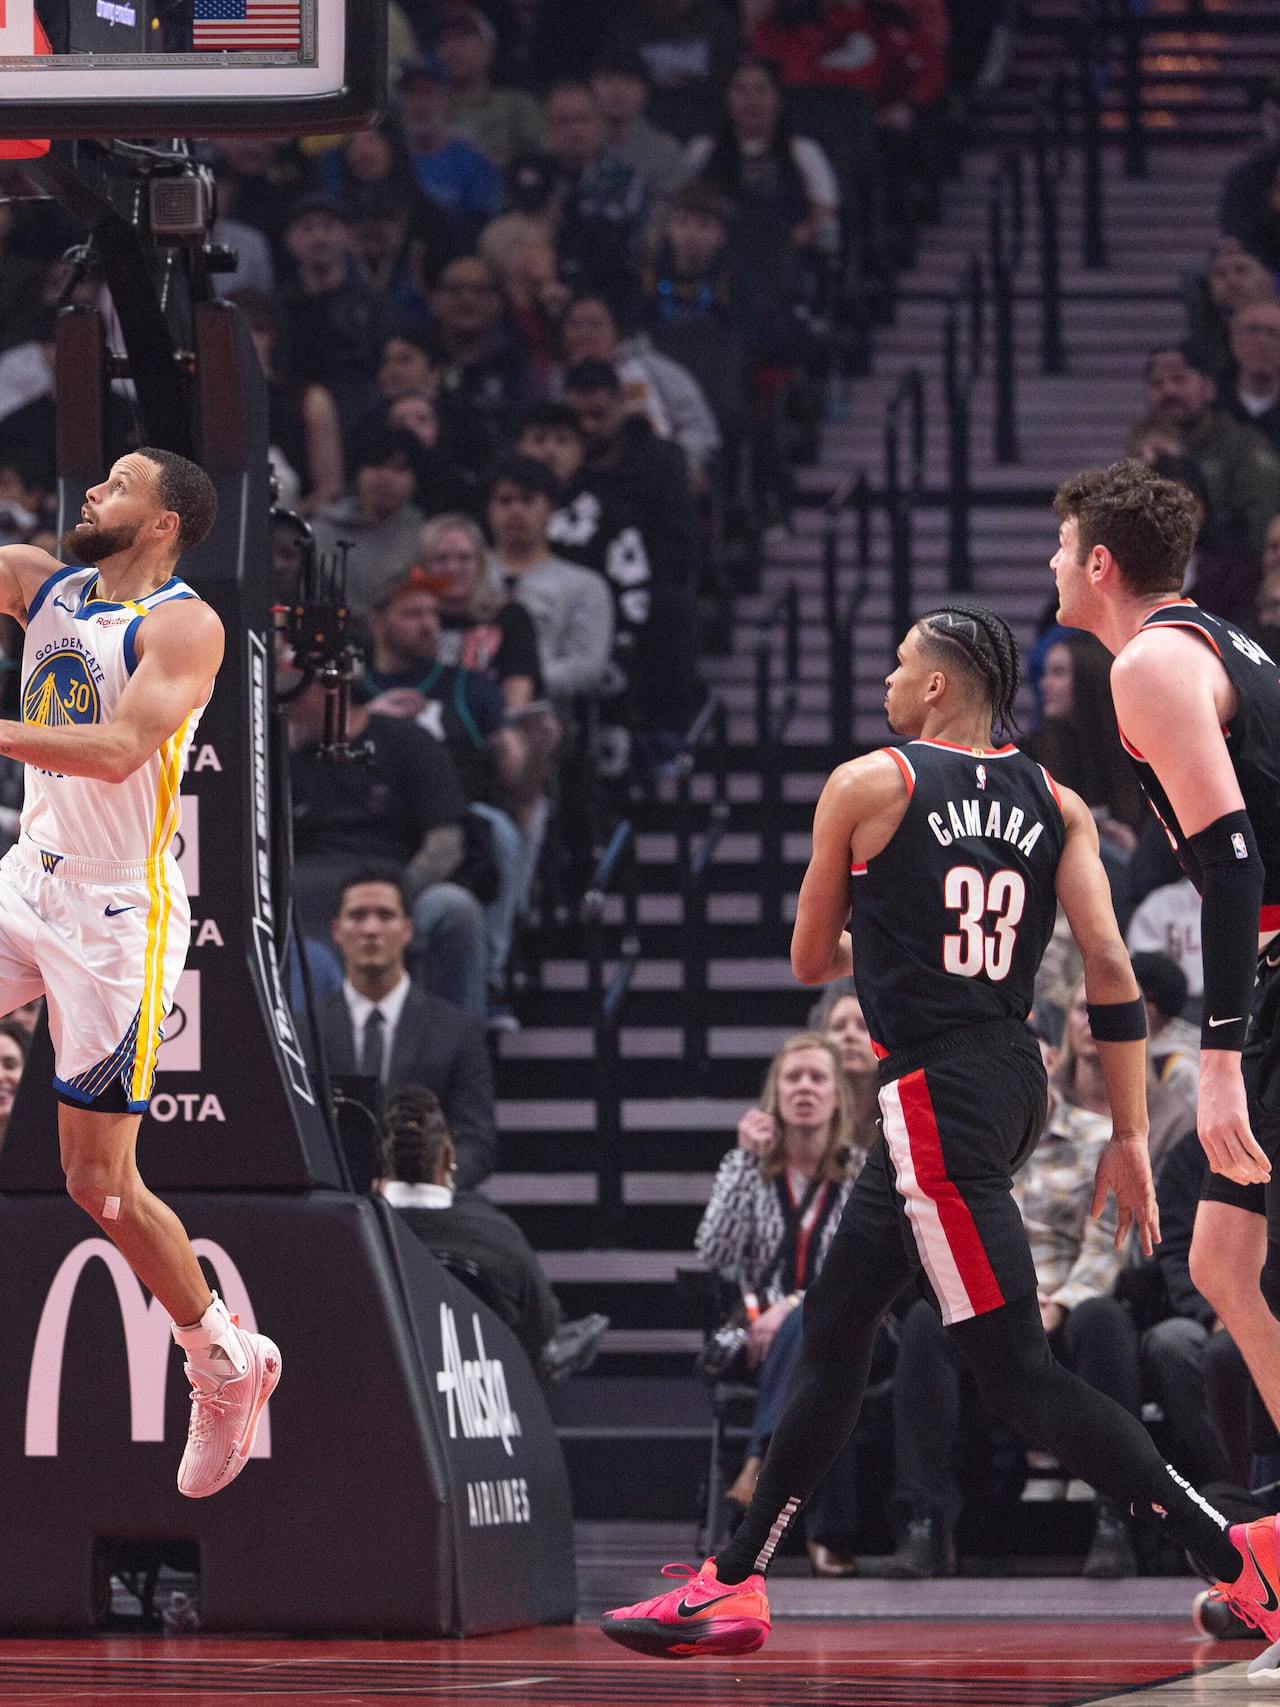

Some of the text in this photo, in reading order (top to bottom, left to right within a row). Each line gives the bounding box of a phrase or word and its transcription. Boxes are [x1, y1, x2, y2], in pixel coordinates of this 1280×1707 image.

[96, 616, 130, 627] Rakuten
[35, 637, 105, 683] GOLDEN TATE
[63, 678, 90, 713] 30
[926, 799, 1044, 858] CAMARA
[942, 864, 1026, 982] 33
[149, 1093, 227, 1123] OTA
[467, 1478, 530, 1527] AIRLINES
